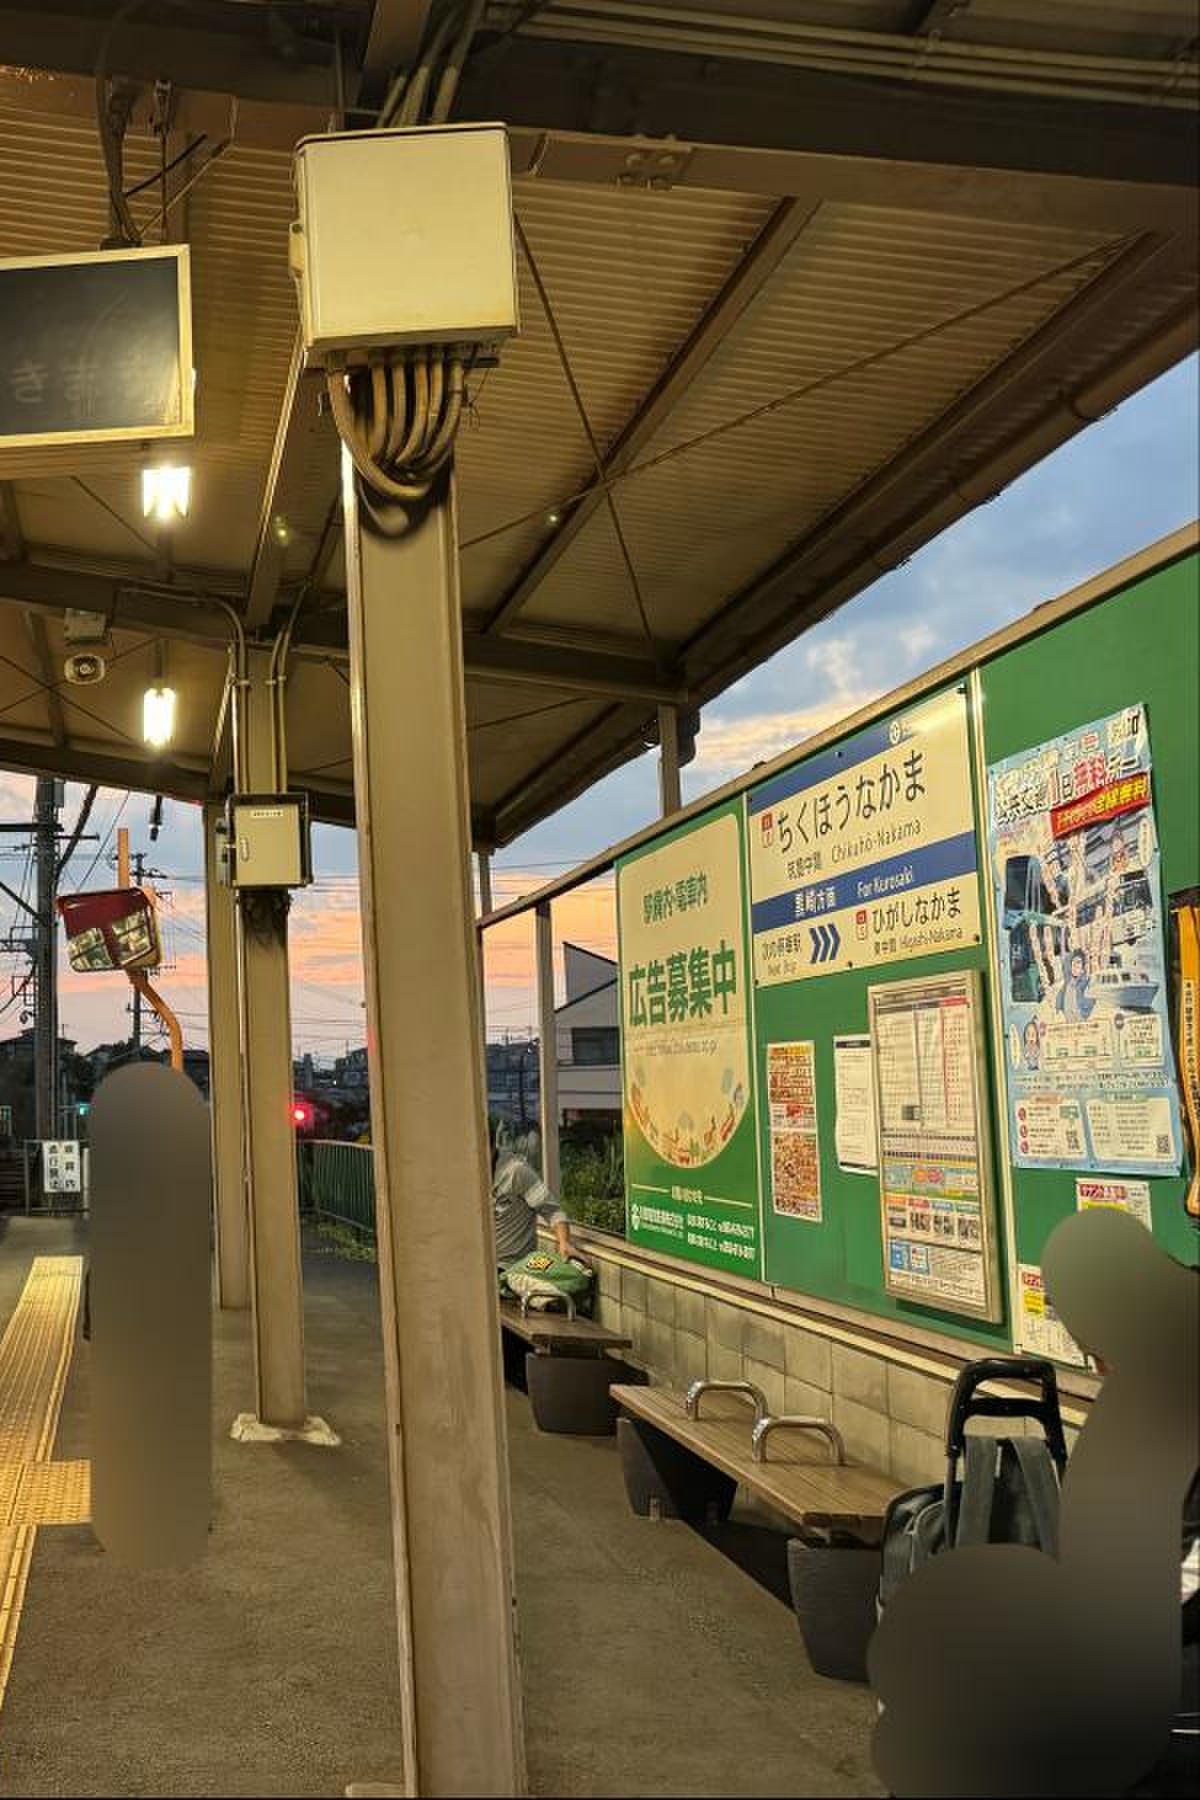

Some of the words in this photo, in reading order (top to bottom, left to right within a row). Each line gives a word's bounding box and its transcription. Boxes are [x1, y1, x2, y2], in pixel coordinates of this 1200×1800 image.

[777, 749, 926, 854] ちくほうなかま
[872, 887, 961, 934] ひがしなかま
[628, 939, 737, 1027] 広告募集中
